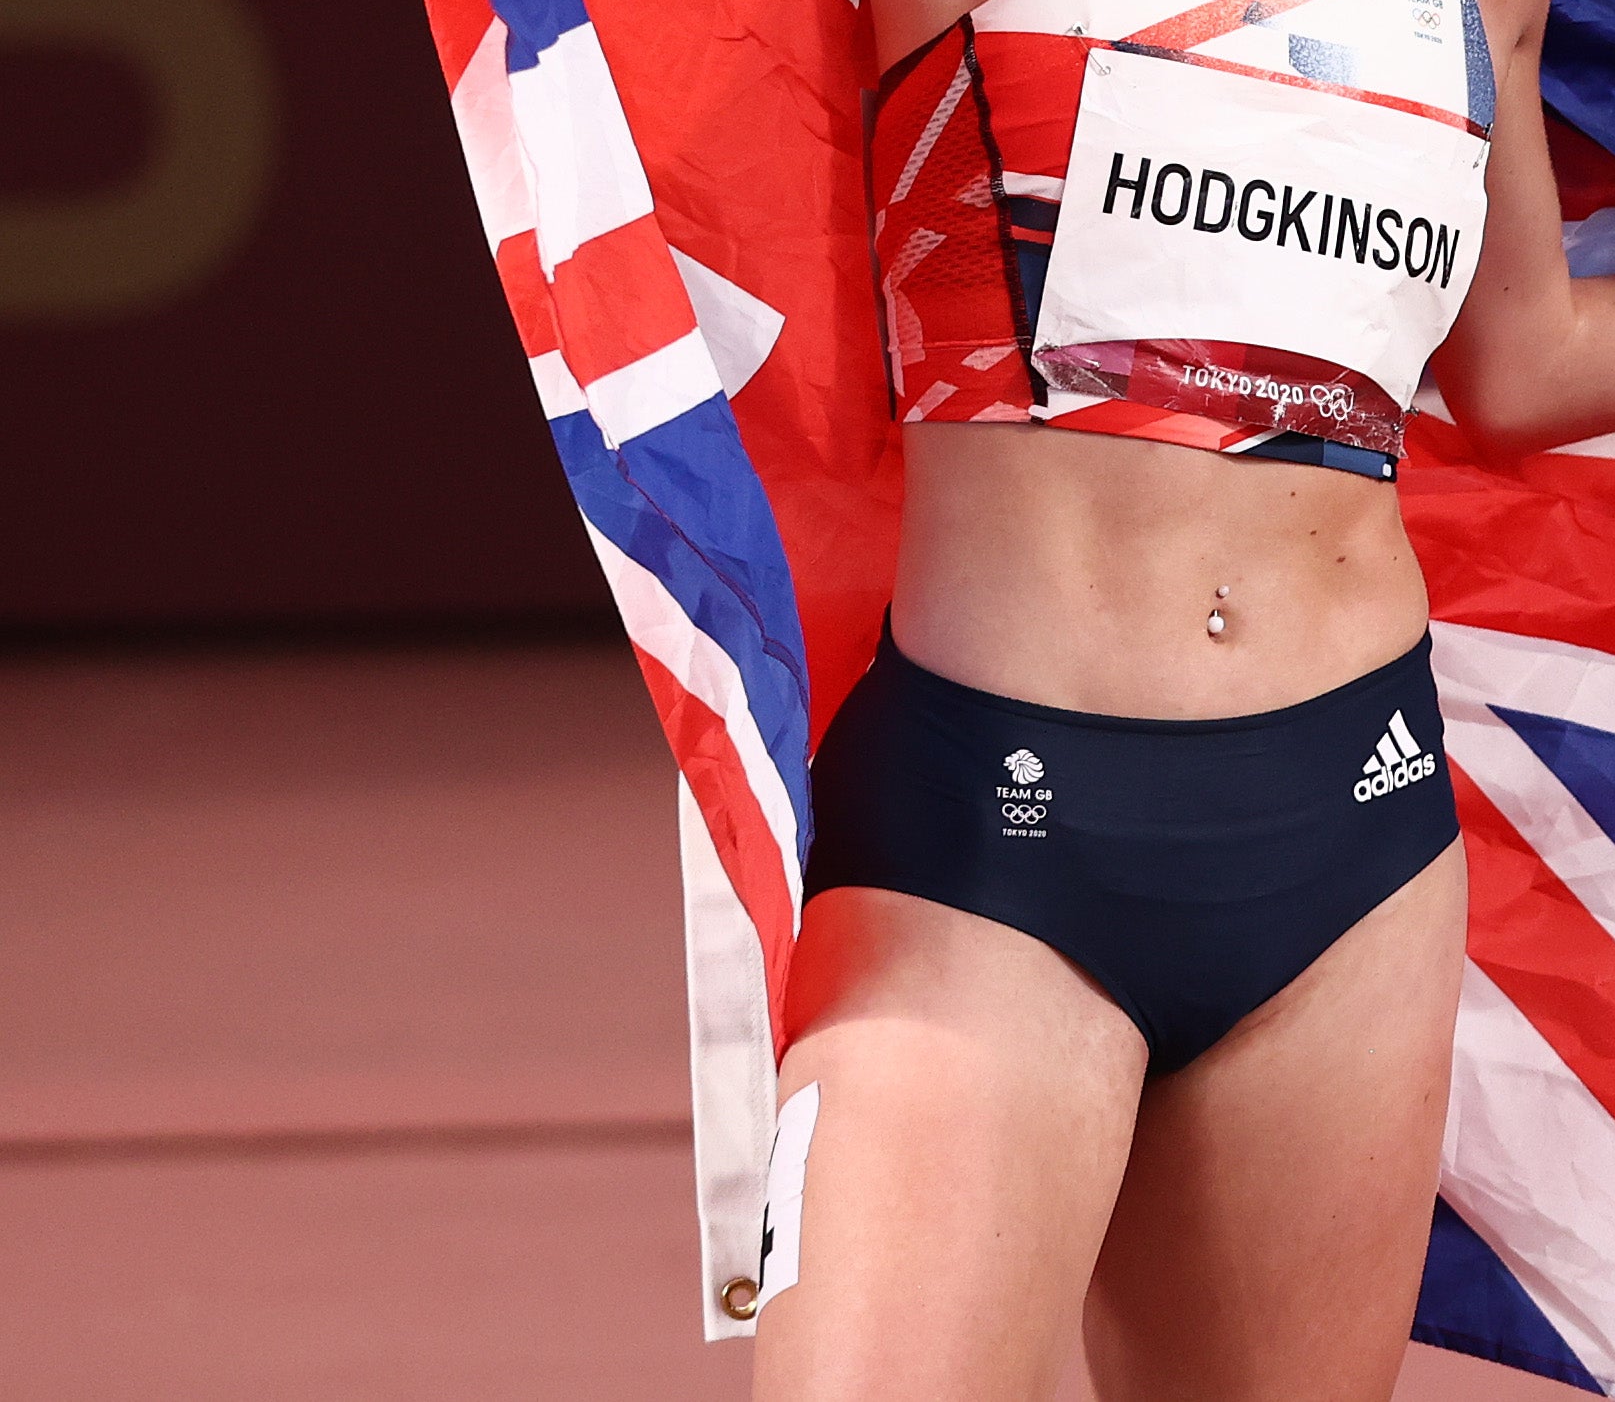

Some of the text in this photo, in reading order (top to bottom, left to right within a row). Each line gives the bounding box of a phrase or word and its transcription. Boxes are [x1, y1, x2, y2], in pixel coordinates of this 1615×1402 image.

[1102, 152, 1460, 288] HODGKINSON
[1182, 365, 1304, 404] TOKYO 2020
[996, 787, 1053, 801] TEAM GB
[1354, 750, 1436, 803] adidas
[1002, 828, 1047, 838] TOKYO 2020
